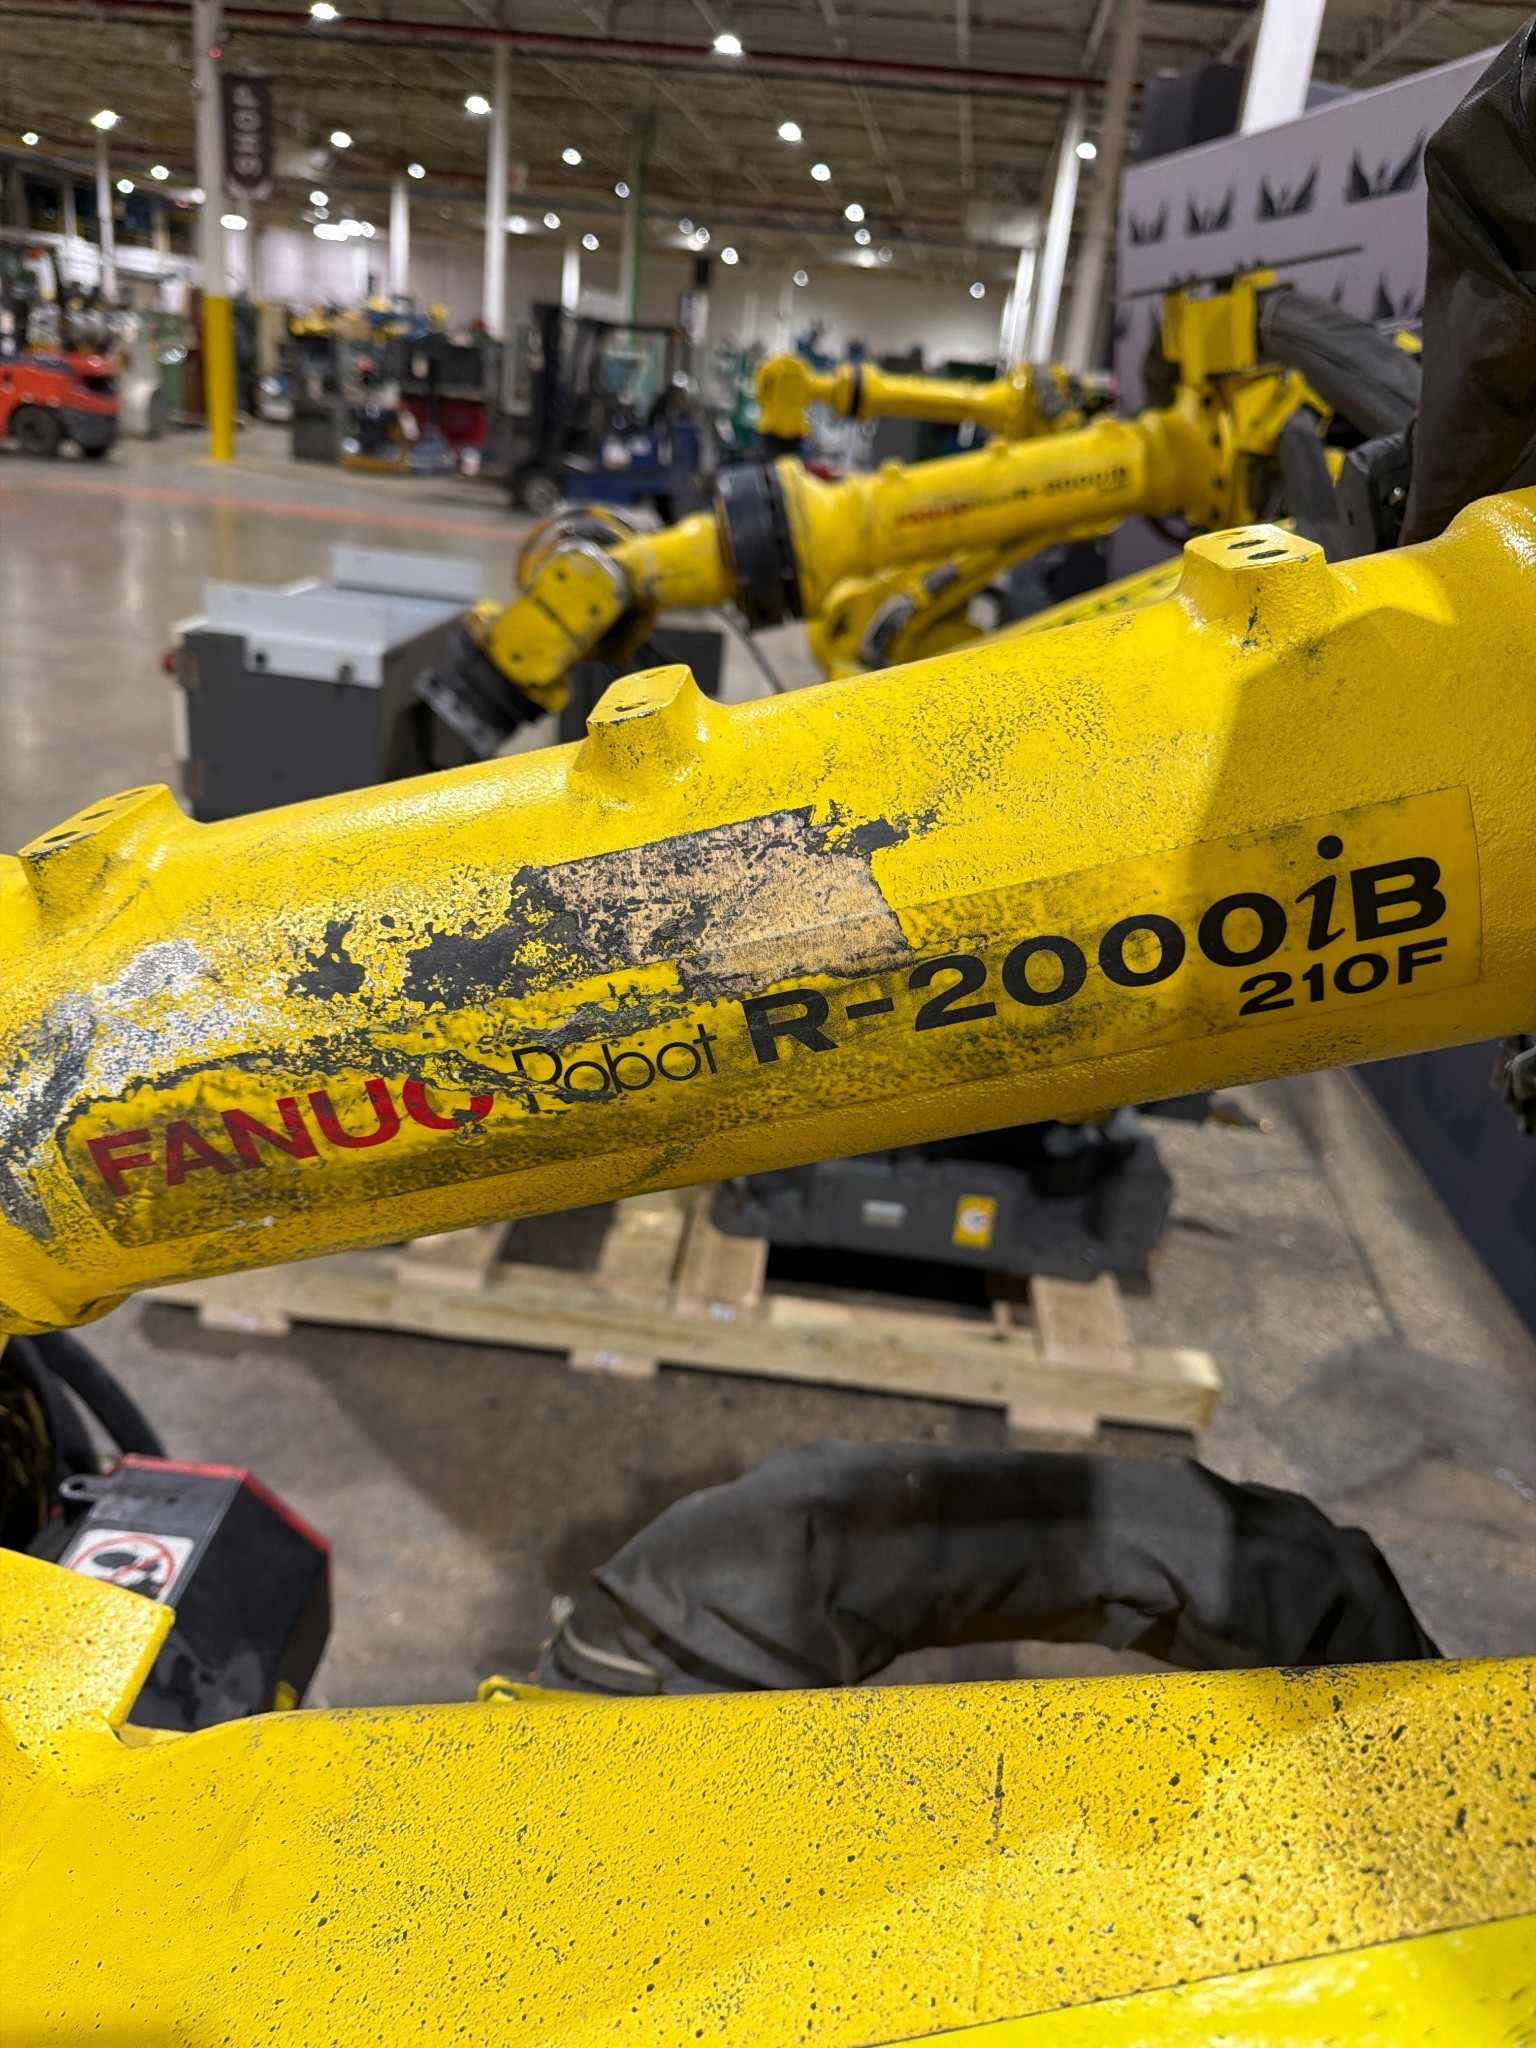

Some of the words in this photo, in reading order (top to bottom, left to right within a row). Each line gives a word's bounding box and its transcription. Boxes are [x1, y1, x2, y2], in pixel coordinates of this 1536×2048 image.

[512, 1023, 718, 1114] Robot
[742, 835, 1447, 1063] R-2000iB
[1239, 937, 1448, 1016] 210F
